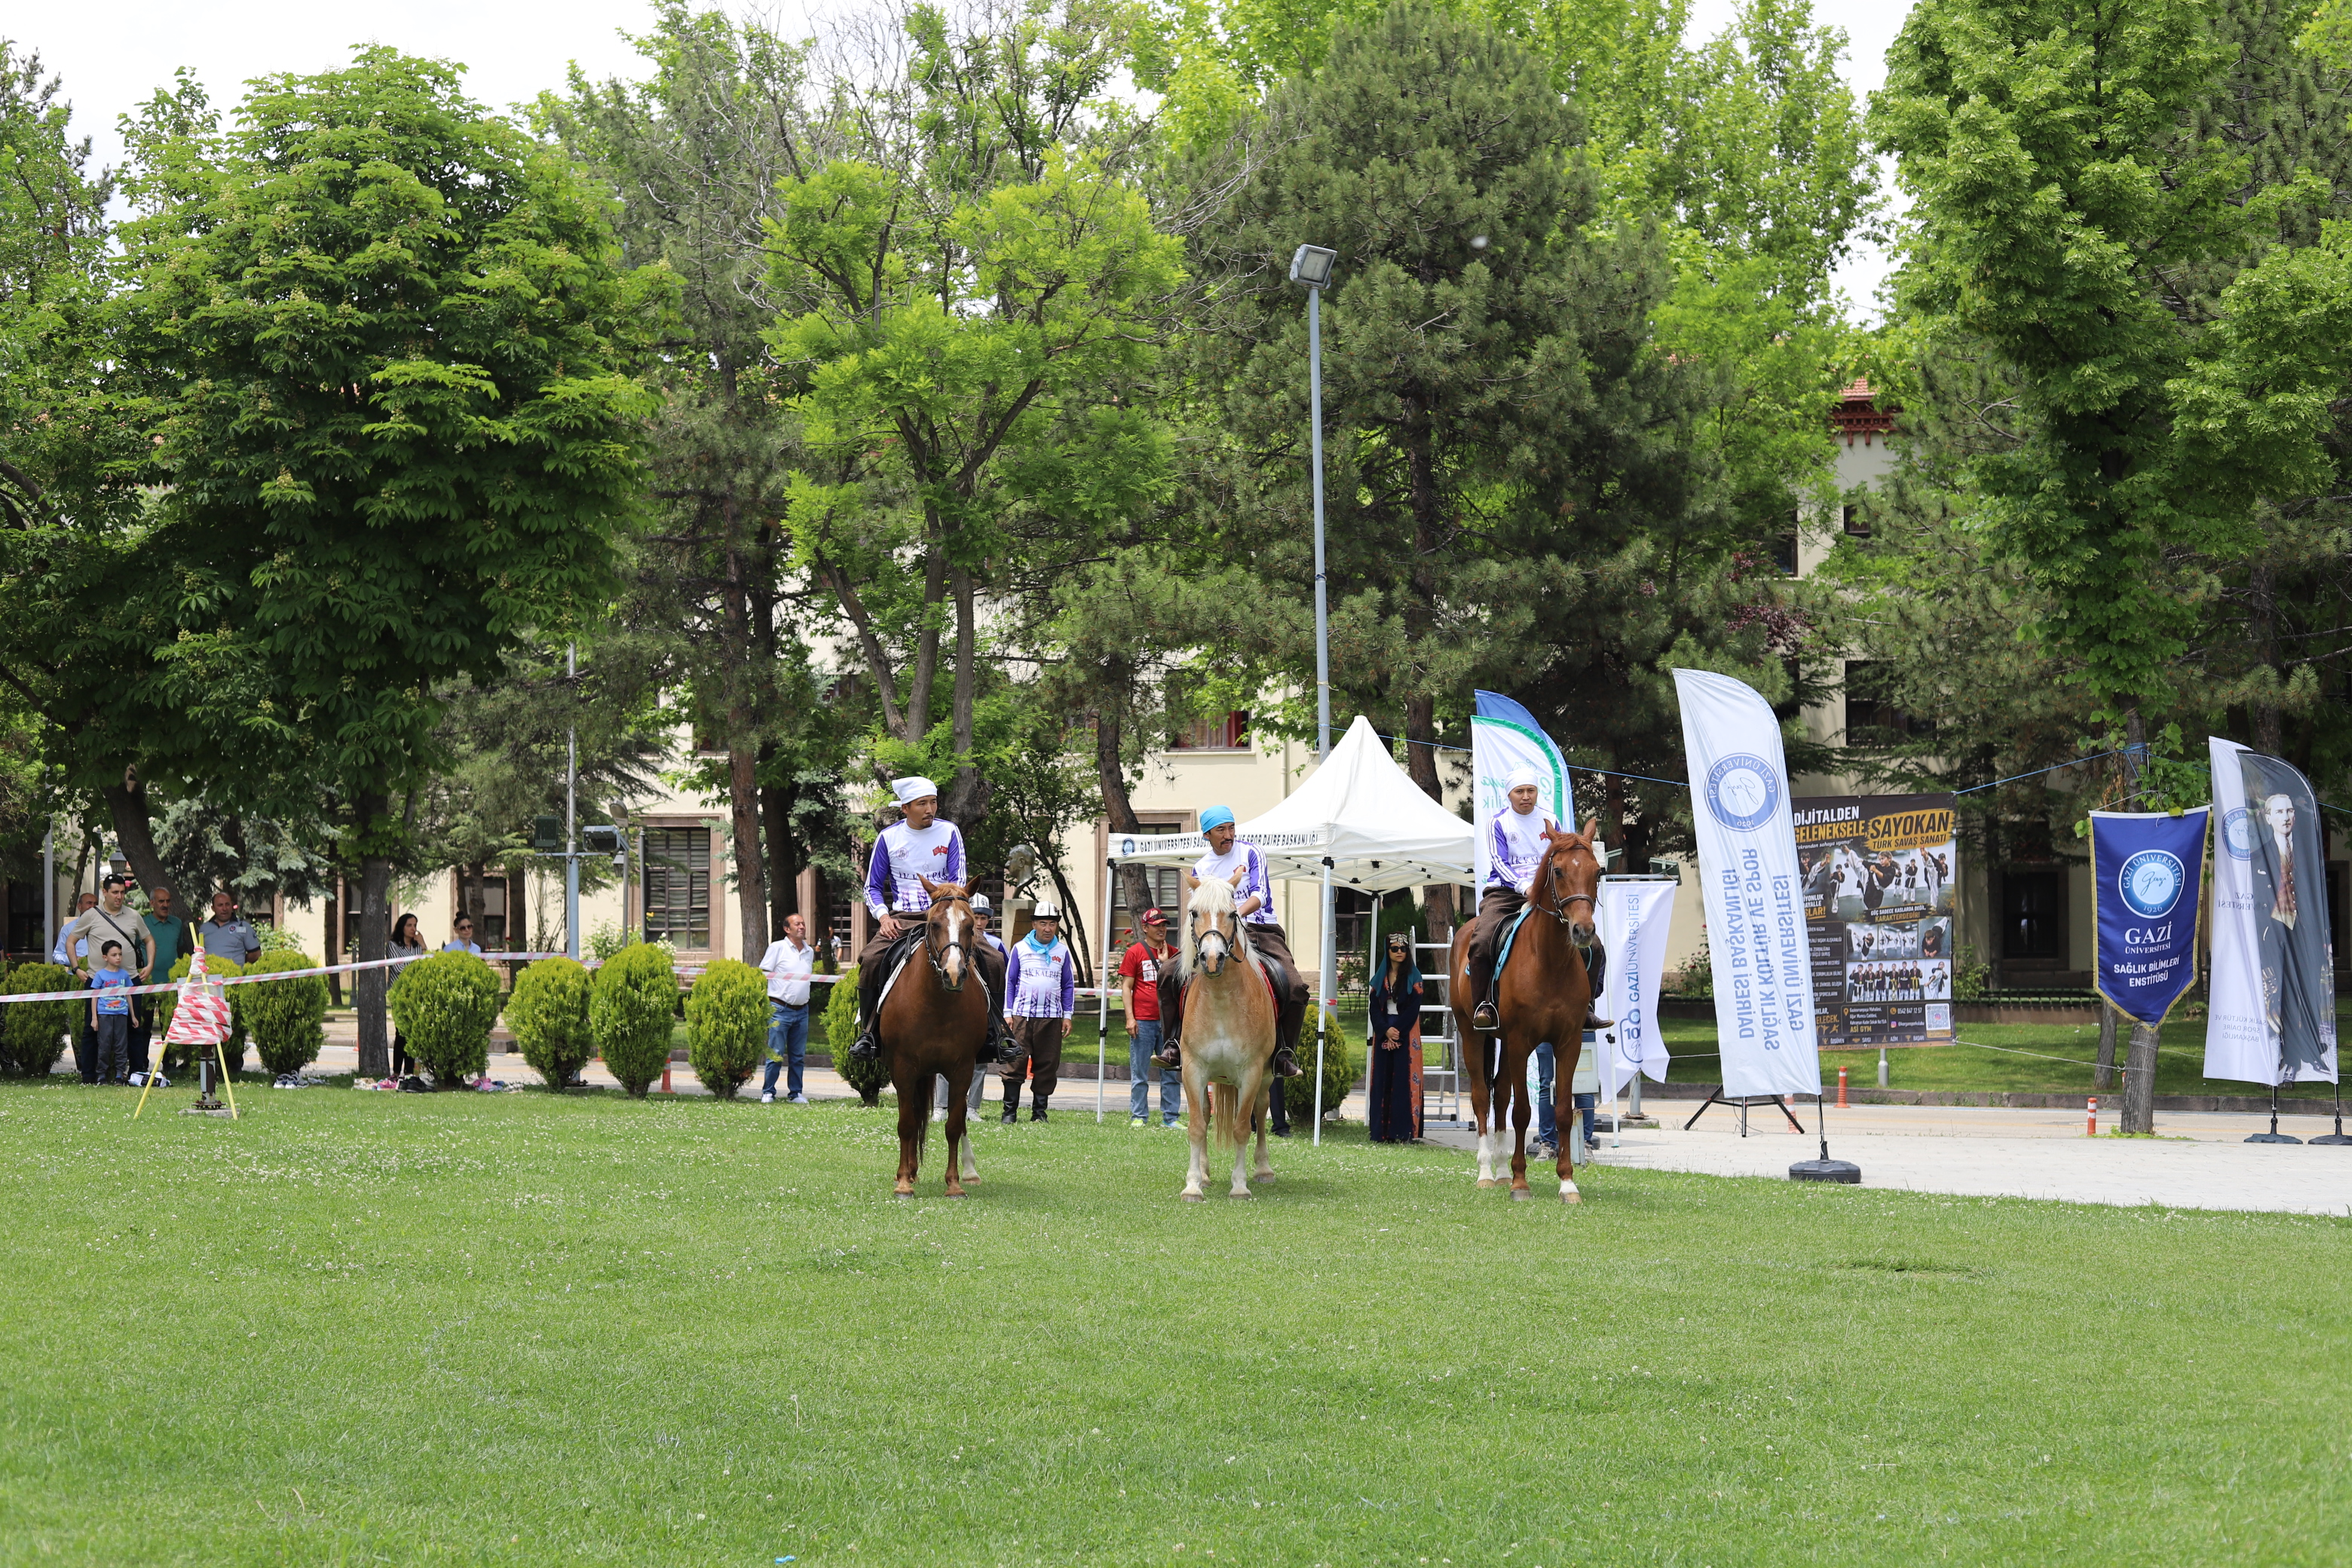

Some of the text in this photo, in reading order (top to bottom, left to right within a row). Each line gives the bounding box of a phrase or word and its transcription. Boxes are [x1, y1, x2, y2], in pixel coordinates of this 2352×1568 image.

[1794, 805, 1860, 826] DİJİTALDEN
[1795, 819, 1868, 843] GELENEKSELE,
[1870, 811, 1949, 839] SAYOKAN
[1141, 838, 1153, 853] GAZİ
[1154, 835, 1192, 851] ÜNİVERSİTESİ
[1873, 839, 1892, 850] TÜRK
[1894, 837, 1918, 848] SAVAŞ
[2124, 853, 2181, 888] GAZİ ÜNİVERSİTESİ
[1803, 893, 1824, 902] İYONLUK
[1805, 906, 1826, 917] ŞLAR!
[2143, 905, 2162, 914] 1926
[2124, 920, 2173, 945] GAZİ
[2125, 942, 2171, 954] ÜNİVERSİTESİ
[2114, 954, 2180, 973] SAĞLIK BİLİMLERİ
[2129, 969, 2168, 987] ENSTİTÜSÜ
[1816, 1014, 1839, 1024] ELECEK.
